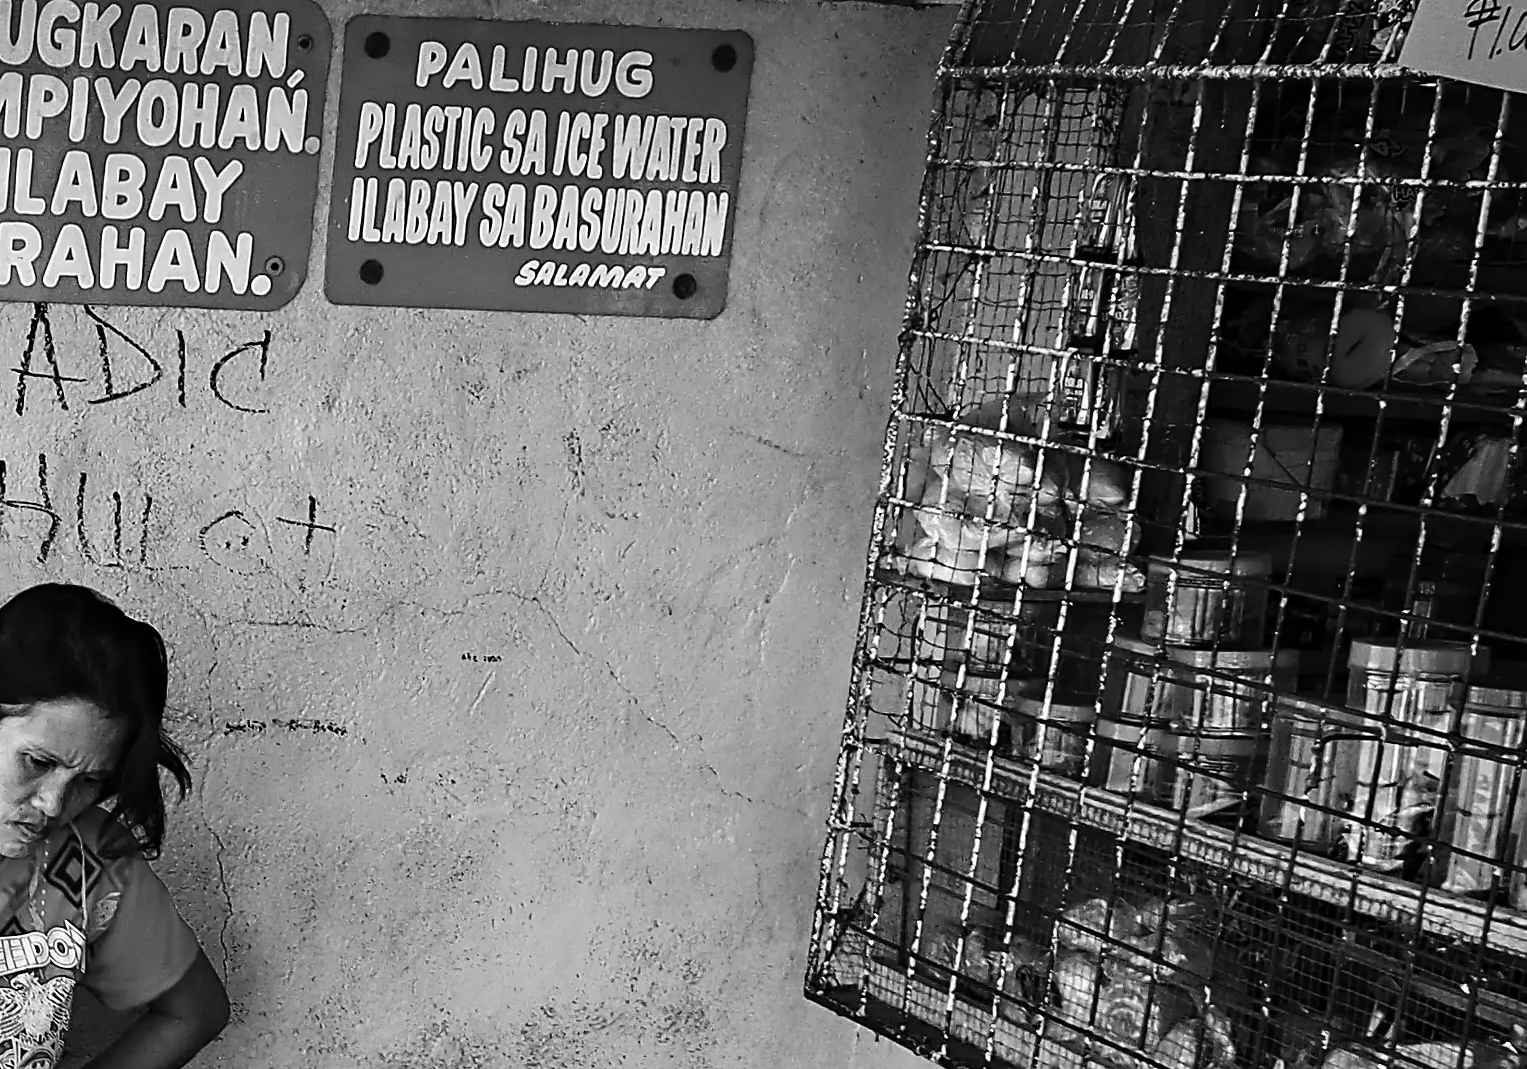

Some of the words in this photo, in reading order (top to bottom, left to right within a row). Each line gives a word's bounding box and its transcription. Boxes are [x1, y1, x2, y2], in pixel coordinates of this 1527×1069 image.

[415, 41, 654, 98] PALIHUG
[354, 101, 496, 173] PLASTIC
[499, 108, 547, 175] SA
[552, 111, 609, 180] ICE
[612, 114, 728, 184] WATER
[347, 176, 479, 247] ILABAY
[479, 182, 527, 248] SA
[529, 184, 730, 257] BASURAHAN
[514, 259, 667, 290] SALAMAT
